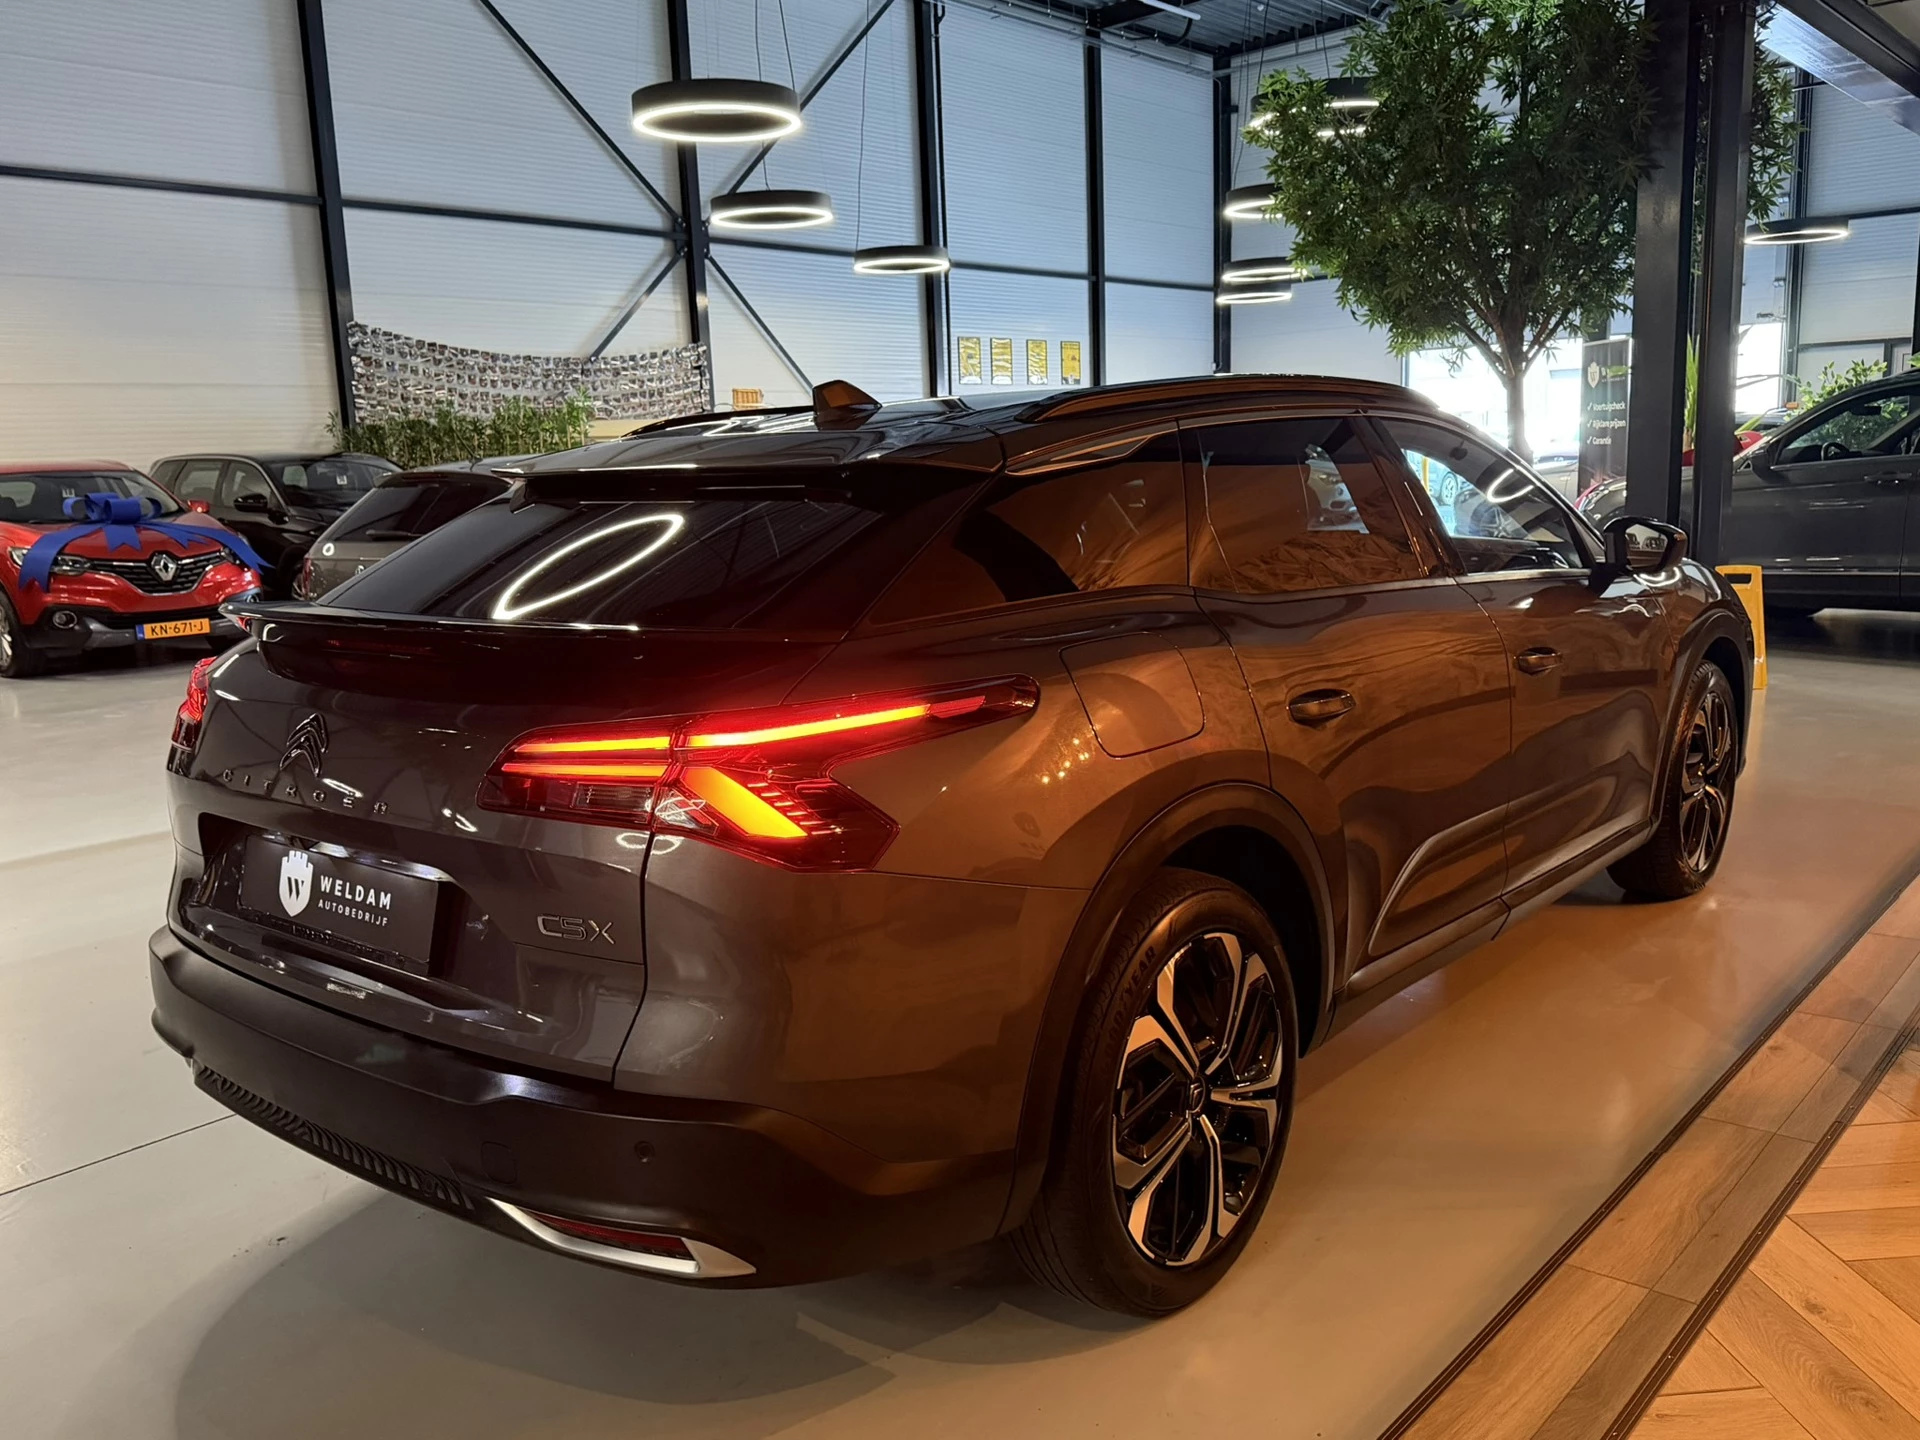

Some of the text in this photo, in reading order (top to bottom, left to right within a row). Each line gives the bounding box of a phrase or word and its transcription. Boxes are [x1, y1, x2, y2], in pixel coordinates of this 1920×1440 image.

[1592, 436, 1611, 445] Garantie
[151, 621, 204, 636] KN-671-J
[320, 875, 392, 910] WELDAM
[318, 899, 388, 927] AUTOBEDRIJF
